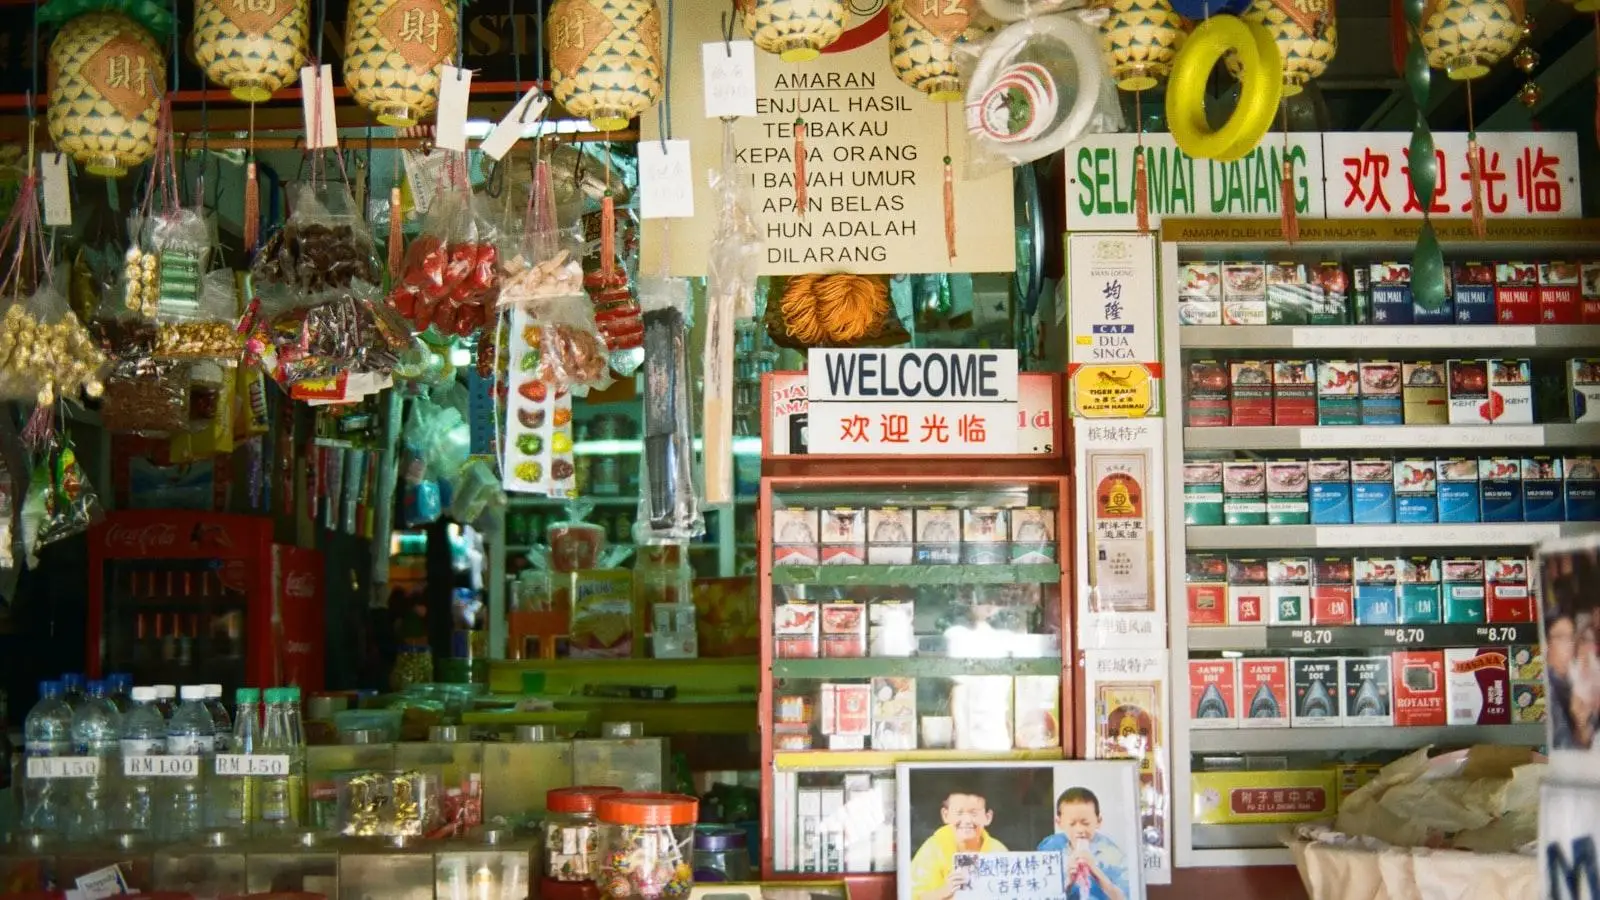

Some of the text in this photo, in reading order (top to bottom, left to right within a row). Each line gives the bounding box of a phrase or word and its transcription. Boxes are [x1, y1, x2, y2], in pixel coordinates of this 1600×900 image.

[774, 72, 876, 88] AMARAN
[756, 95, 912, 113] ENJUAL HASIL
[763, 120, 888, 138] TEMBAKAU
[833, 145, 917, 162] ORANG
[852, 170, 916, 187] UMUR
[1209, 145, 1309, 214] DATANG
[762, 195, 904, 213] APN BELAS
[767, 220, 916, 238] HUN ADALAH
[1182, 228, 1376, 238] AMARAN OLEH KERAAN MALAYSIA
[1452, 228, 1541, 238] MEMAHAYAKAN
[768, 246, 887, 263] DILARANG
[1100, 325, 1127, 333] CAP
[1099, 336, 1129, 347] DUA
[1093, 348, 1135, 359] SINGA
[825, 352, 998, 397] WELCOME
[1452, 400, 1478, 408] KENT
[840, 413, 986, 443] 欢迎光临
[131, 758, 153, 773] RM
[217, 757, 240, 772] RM
